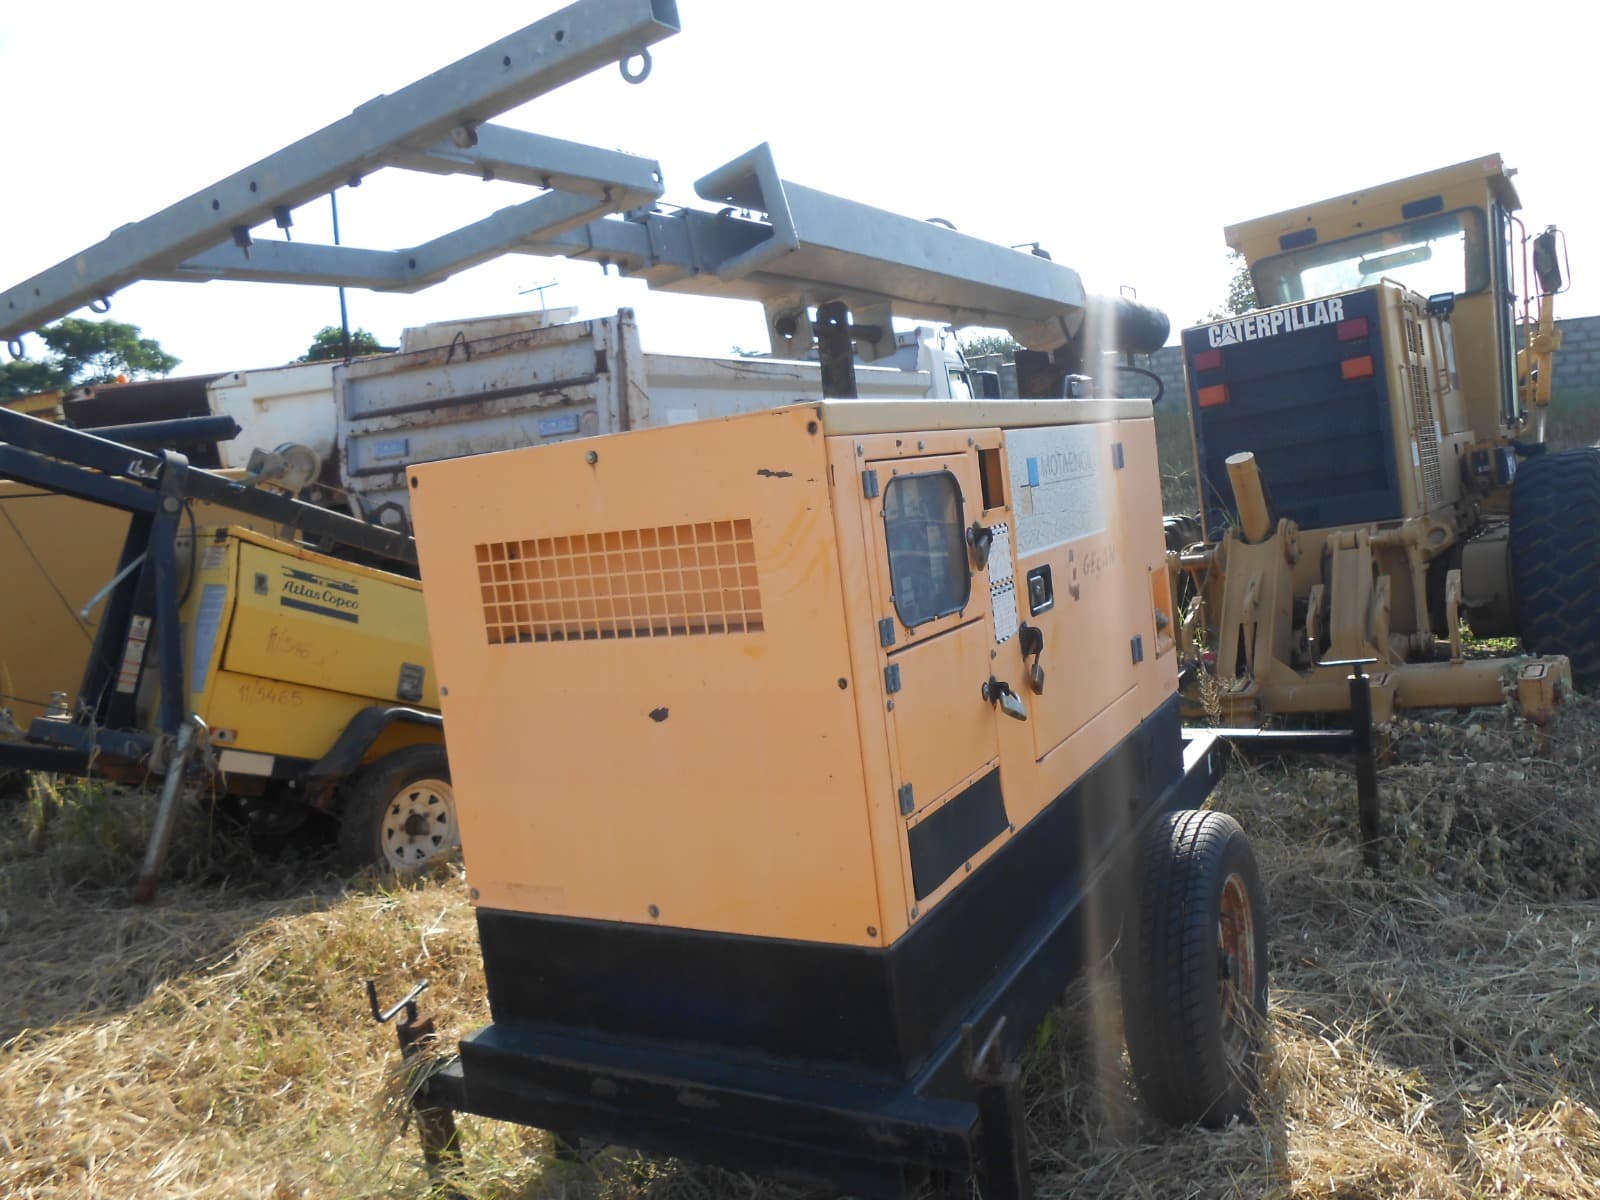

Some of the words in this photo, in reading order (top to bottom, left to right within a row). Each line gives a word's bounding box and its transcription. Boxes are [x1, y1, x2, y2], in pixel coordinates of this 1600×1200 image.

[1208, 298, 1344, 348] CATERPILLAR
[282, 580, 320, 600] Atlas
[322, 590, 359, 610] Copco
